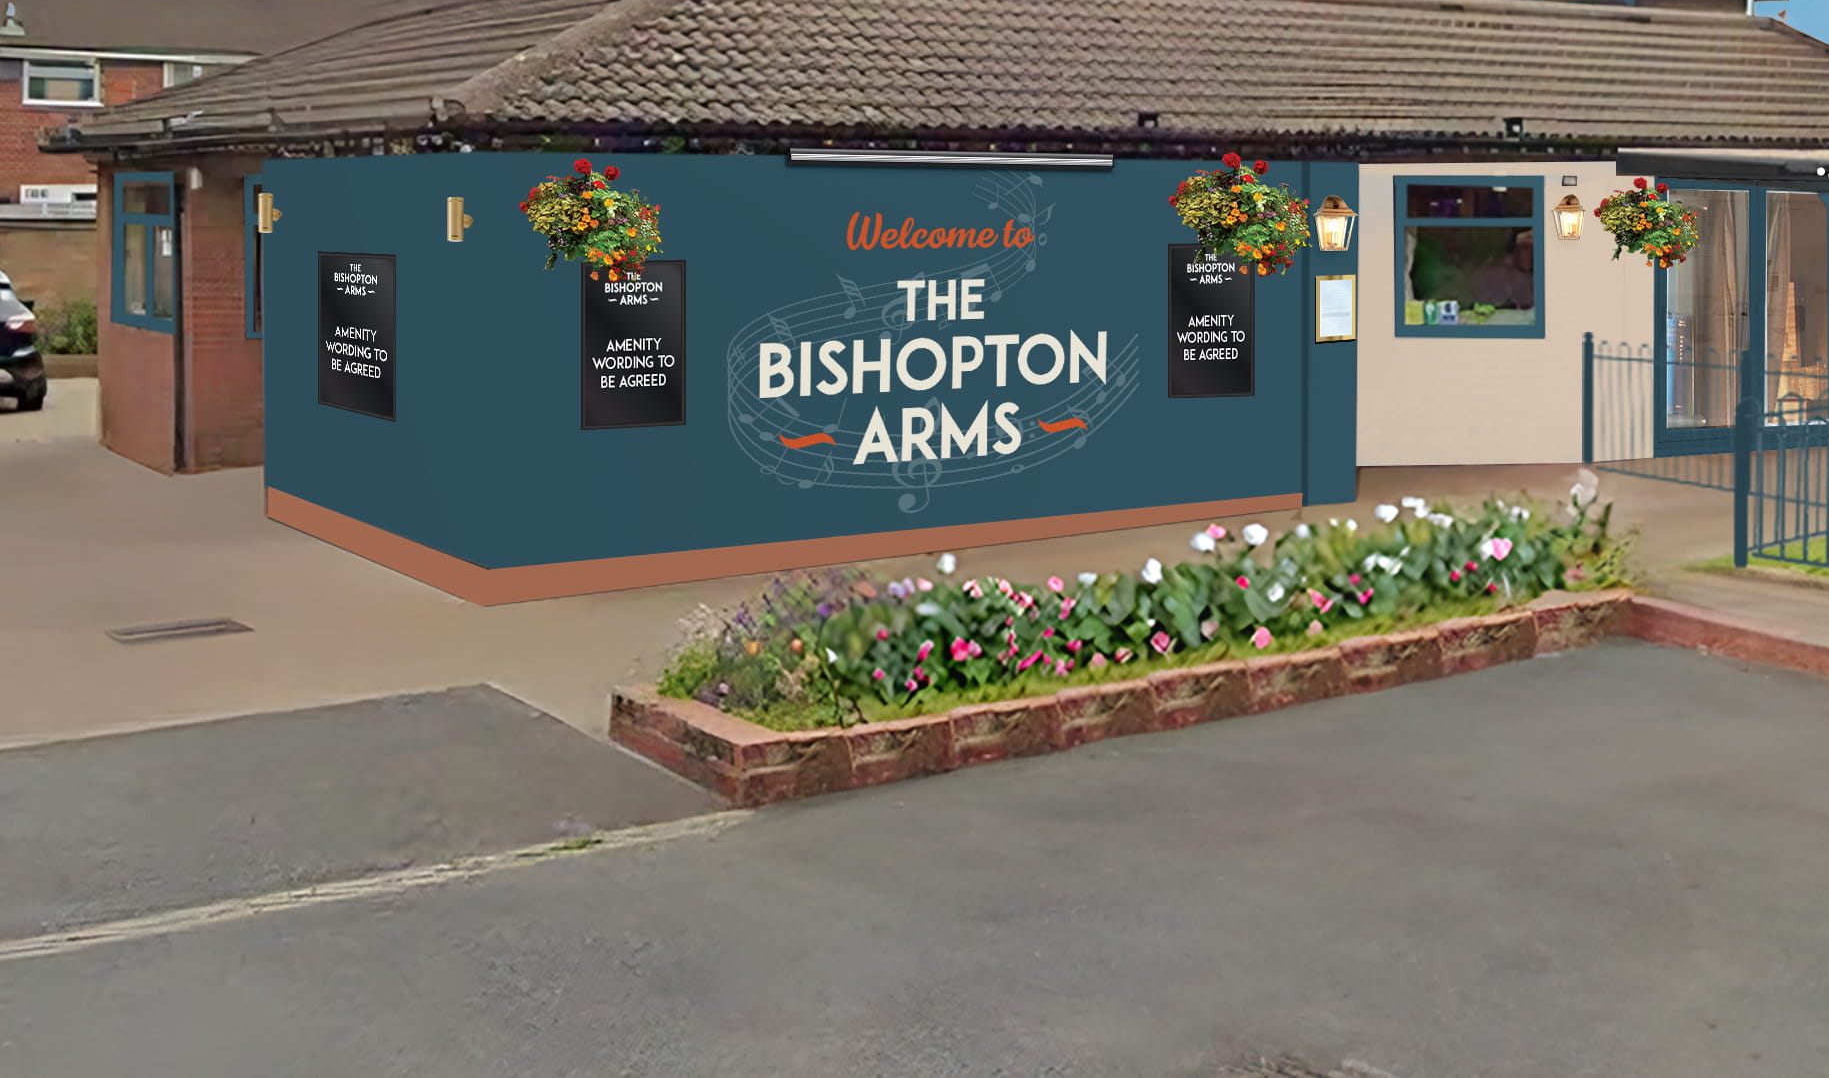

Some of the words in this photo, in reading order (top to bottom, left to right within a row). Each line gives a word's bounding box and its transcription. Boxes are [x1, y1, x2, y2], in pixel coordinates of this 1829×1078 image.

[846, 212, 999, 251] Welcome
[1002, 219, 1035, 248] to
[1205, 253, 1217, 262] THE
[350, 263, 362, 272] THE
[1187, 262, 1235, 273] BISHOPTON
[334, 272, 378, 285] BISHOPTON
[1199, 274, 1223, 284] ARMS
[344, 285, 366, 296] ARMS
[604, 282, 663, 293] BISHOPTON
[620, 294, 648, 305] ARMS
[897, 279, 985, 322] THE
[1188, 314, 1234, 327] AMENITY
[334, 326, 377, 342] AMENITY
[1177, 331, 1228, 344] WORDING
[1231, 330, 1246, 342] TO
[326, 340, 372, 360] WORDING
[374, 348, 388, 362] TO
[606, 338, 662, 352] AMENITY
[1183, 348, 1196, 361] BE
[1199, 348, 1239, 360] AGREED
[331, 358, 342, 371] BE
[344, 361, 381, 379] AGREED
[592, 355, 654, 370] WORDING
[658, 355, 675, 368] TO
[759, 329, 1107, 399] BISHOPTON
[600, 375, 616, 388] BE
[619, 373, 667, 388] AGREED
[852, 400, 1022, 465] ARMS
